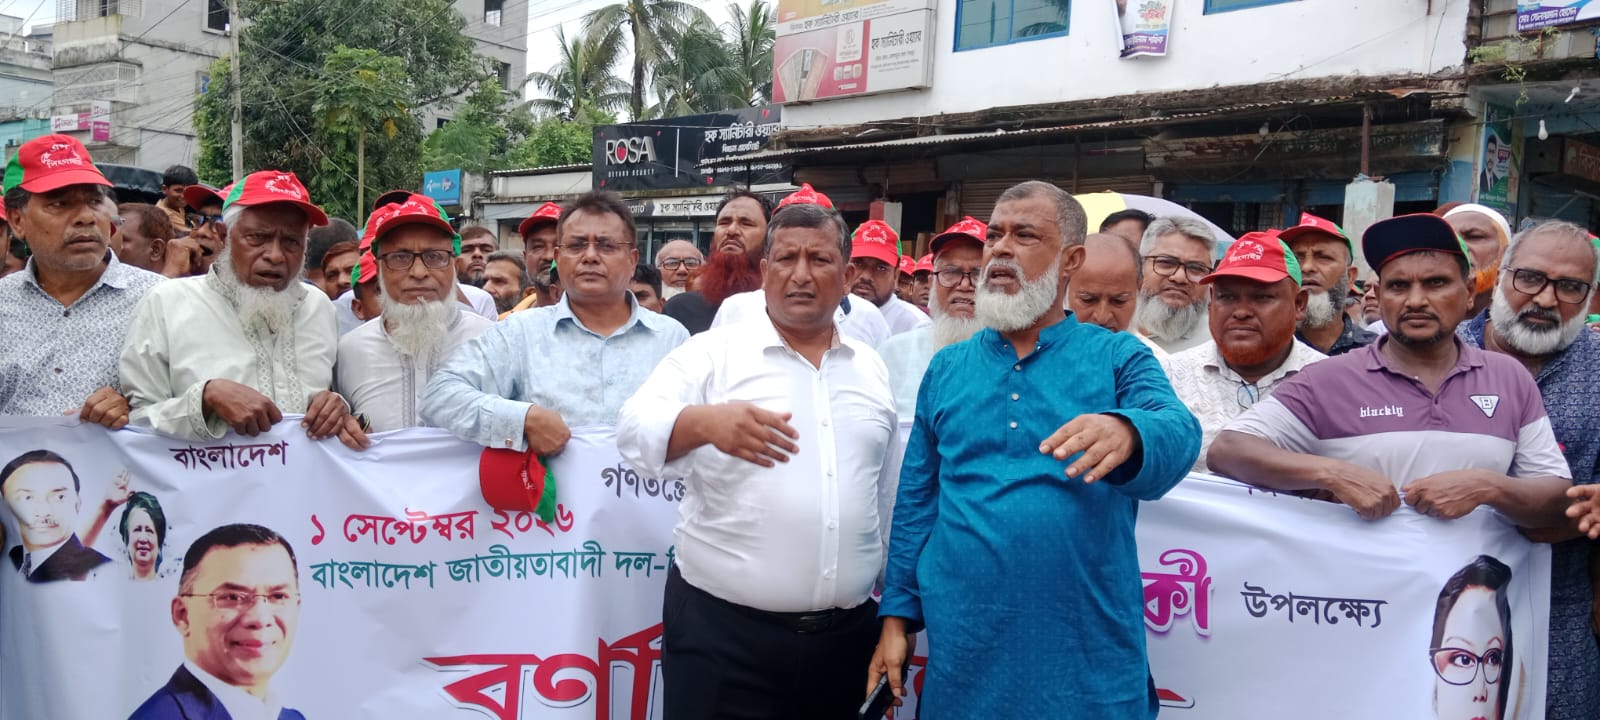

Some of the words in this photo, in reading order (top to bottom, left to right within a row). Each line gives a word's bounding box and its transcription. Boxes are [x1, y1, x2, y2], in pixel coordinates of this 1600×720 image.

[605, 136, 656, 166] ROSA
[168, 440, 288, 471] বাংলাদেশ
[311, 514, 325, 545] ১
[343, 507, 479, 545] সেপ্টেম্বর
[309, 557, 437, 590] বাংলাদেশ
[445, 540, 606, 583] জাতীয়তাবাদী
[1240, 581, 1388, 628] উপলক্ষ্যে
